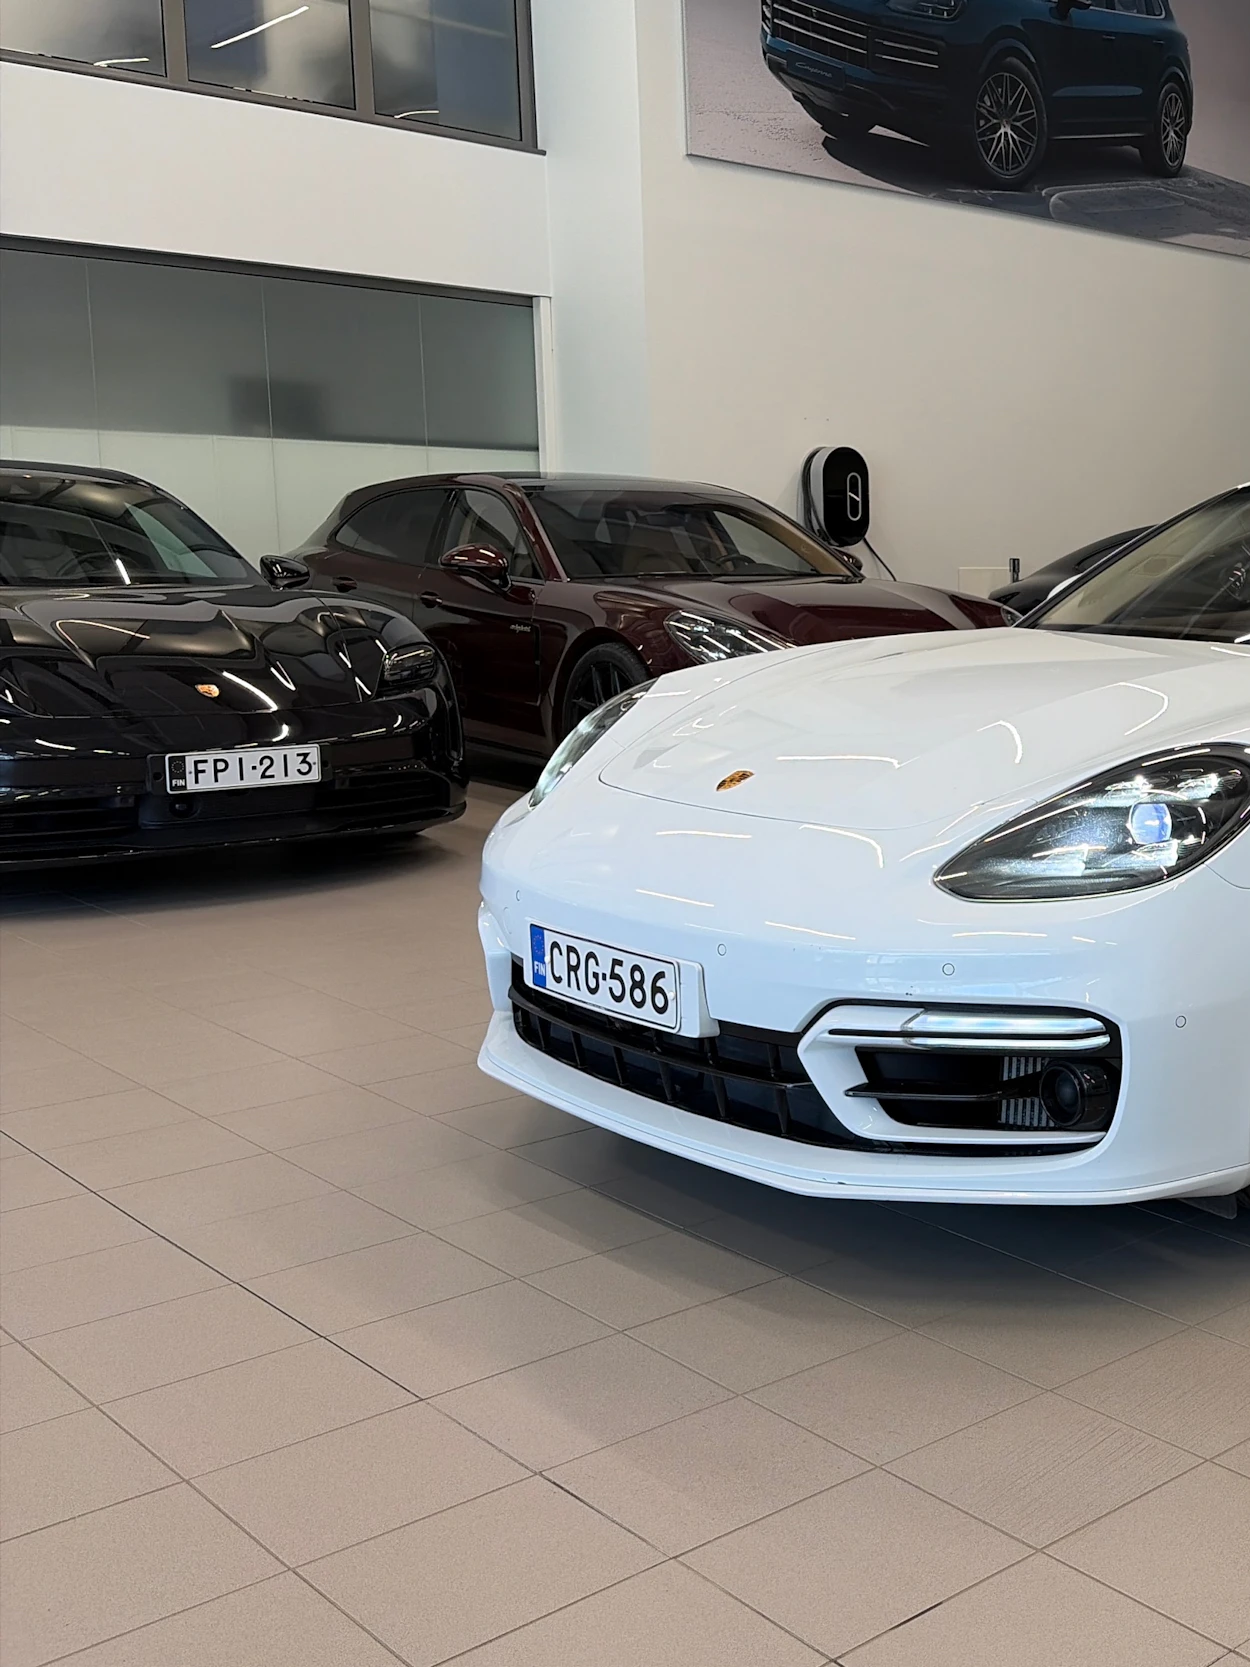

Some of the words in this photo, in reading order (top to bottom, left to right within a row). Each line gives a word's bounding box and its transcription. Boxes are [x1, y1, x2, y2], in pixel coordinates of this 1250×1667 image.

[193, 752, 313, 785] FPI-213
[172, 778, 186, 787] FIN
[534, 961, 546, 977] FIN
[550, 940, 669, 1015] CRG-586
